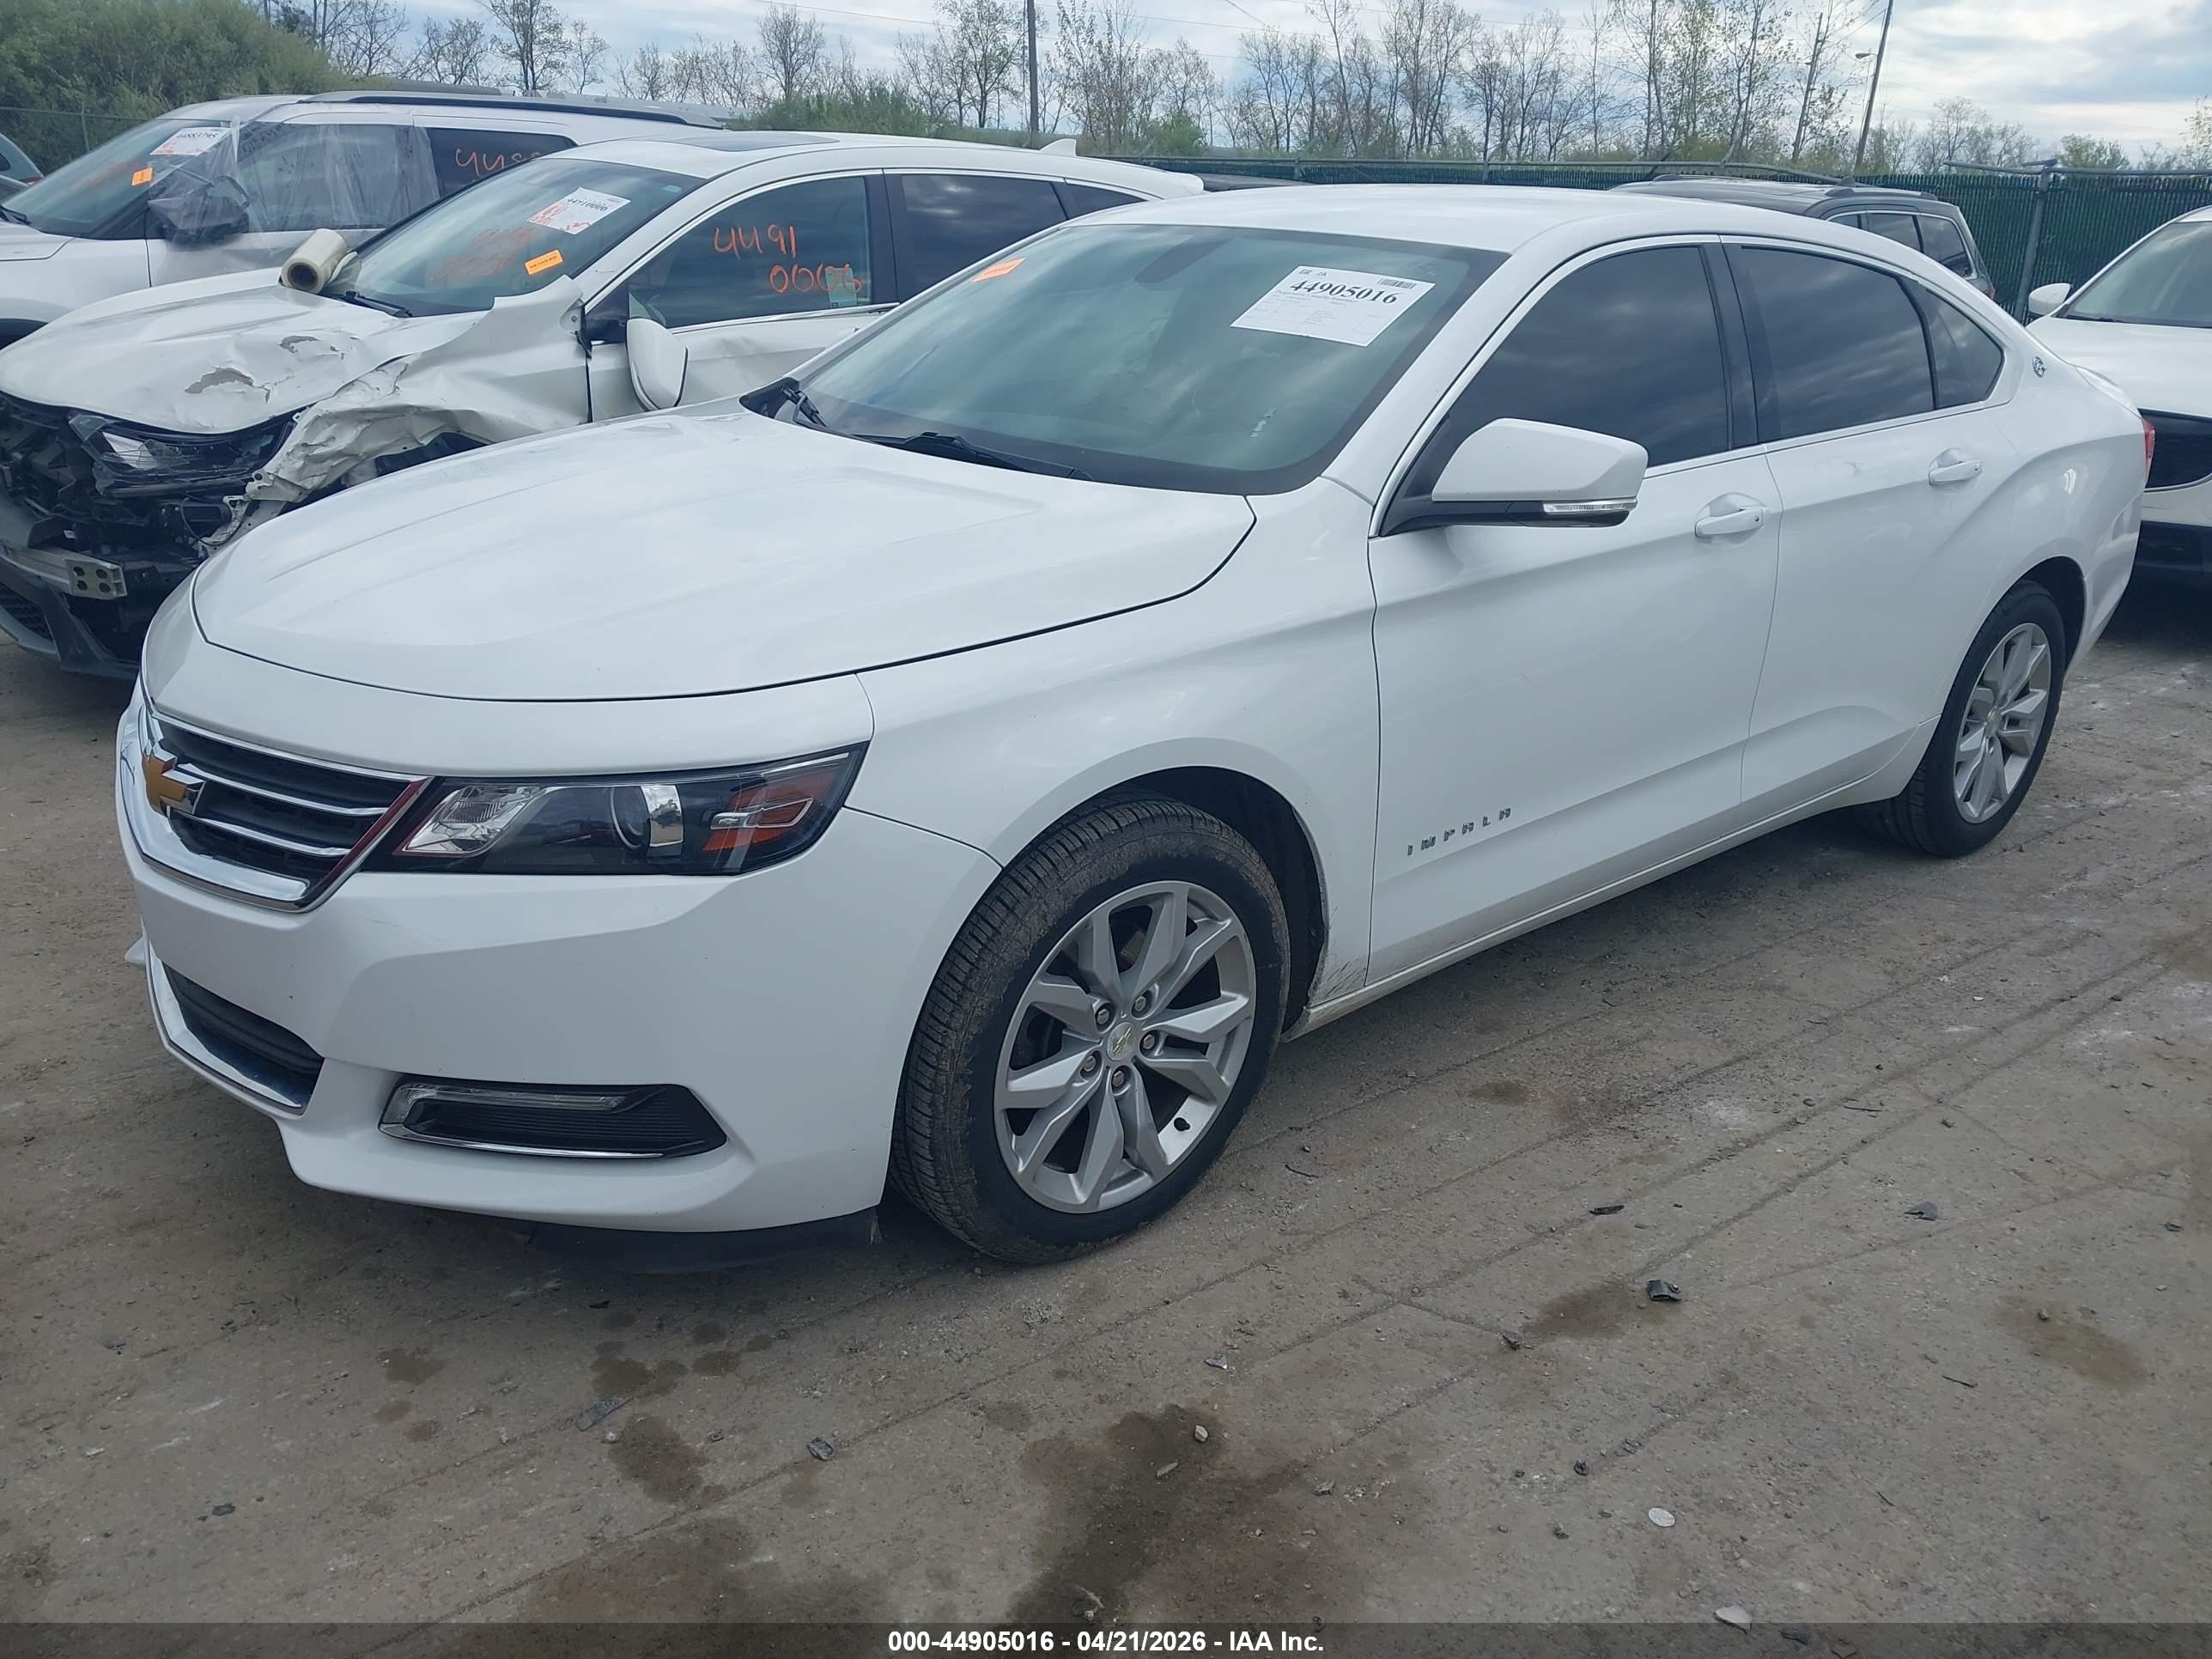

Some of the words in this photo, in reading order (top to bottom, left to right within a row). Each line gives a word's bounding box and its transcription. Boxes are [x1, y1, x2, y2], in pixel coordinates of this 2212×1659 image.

[713, 223, 797, 260] 4491
[1290, 280, 1401, 304] 44905016
[1407, 807, 1511, 856] IMPALA
